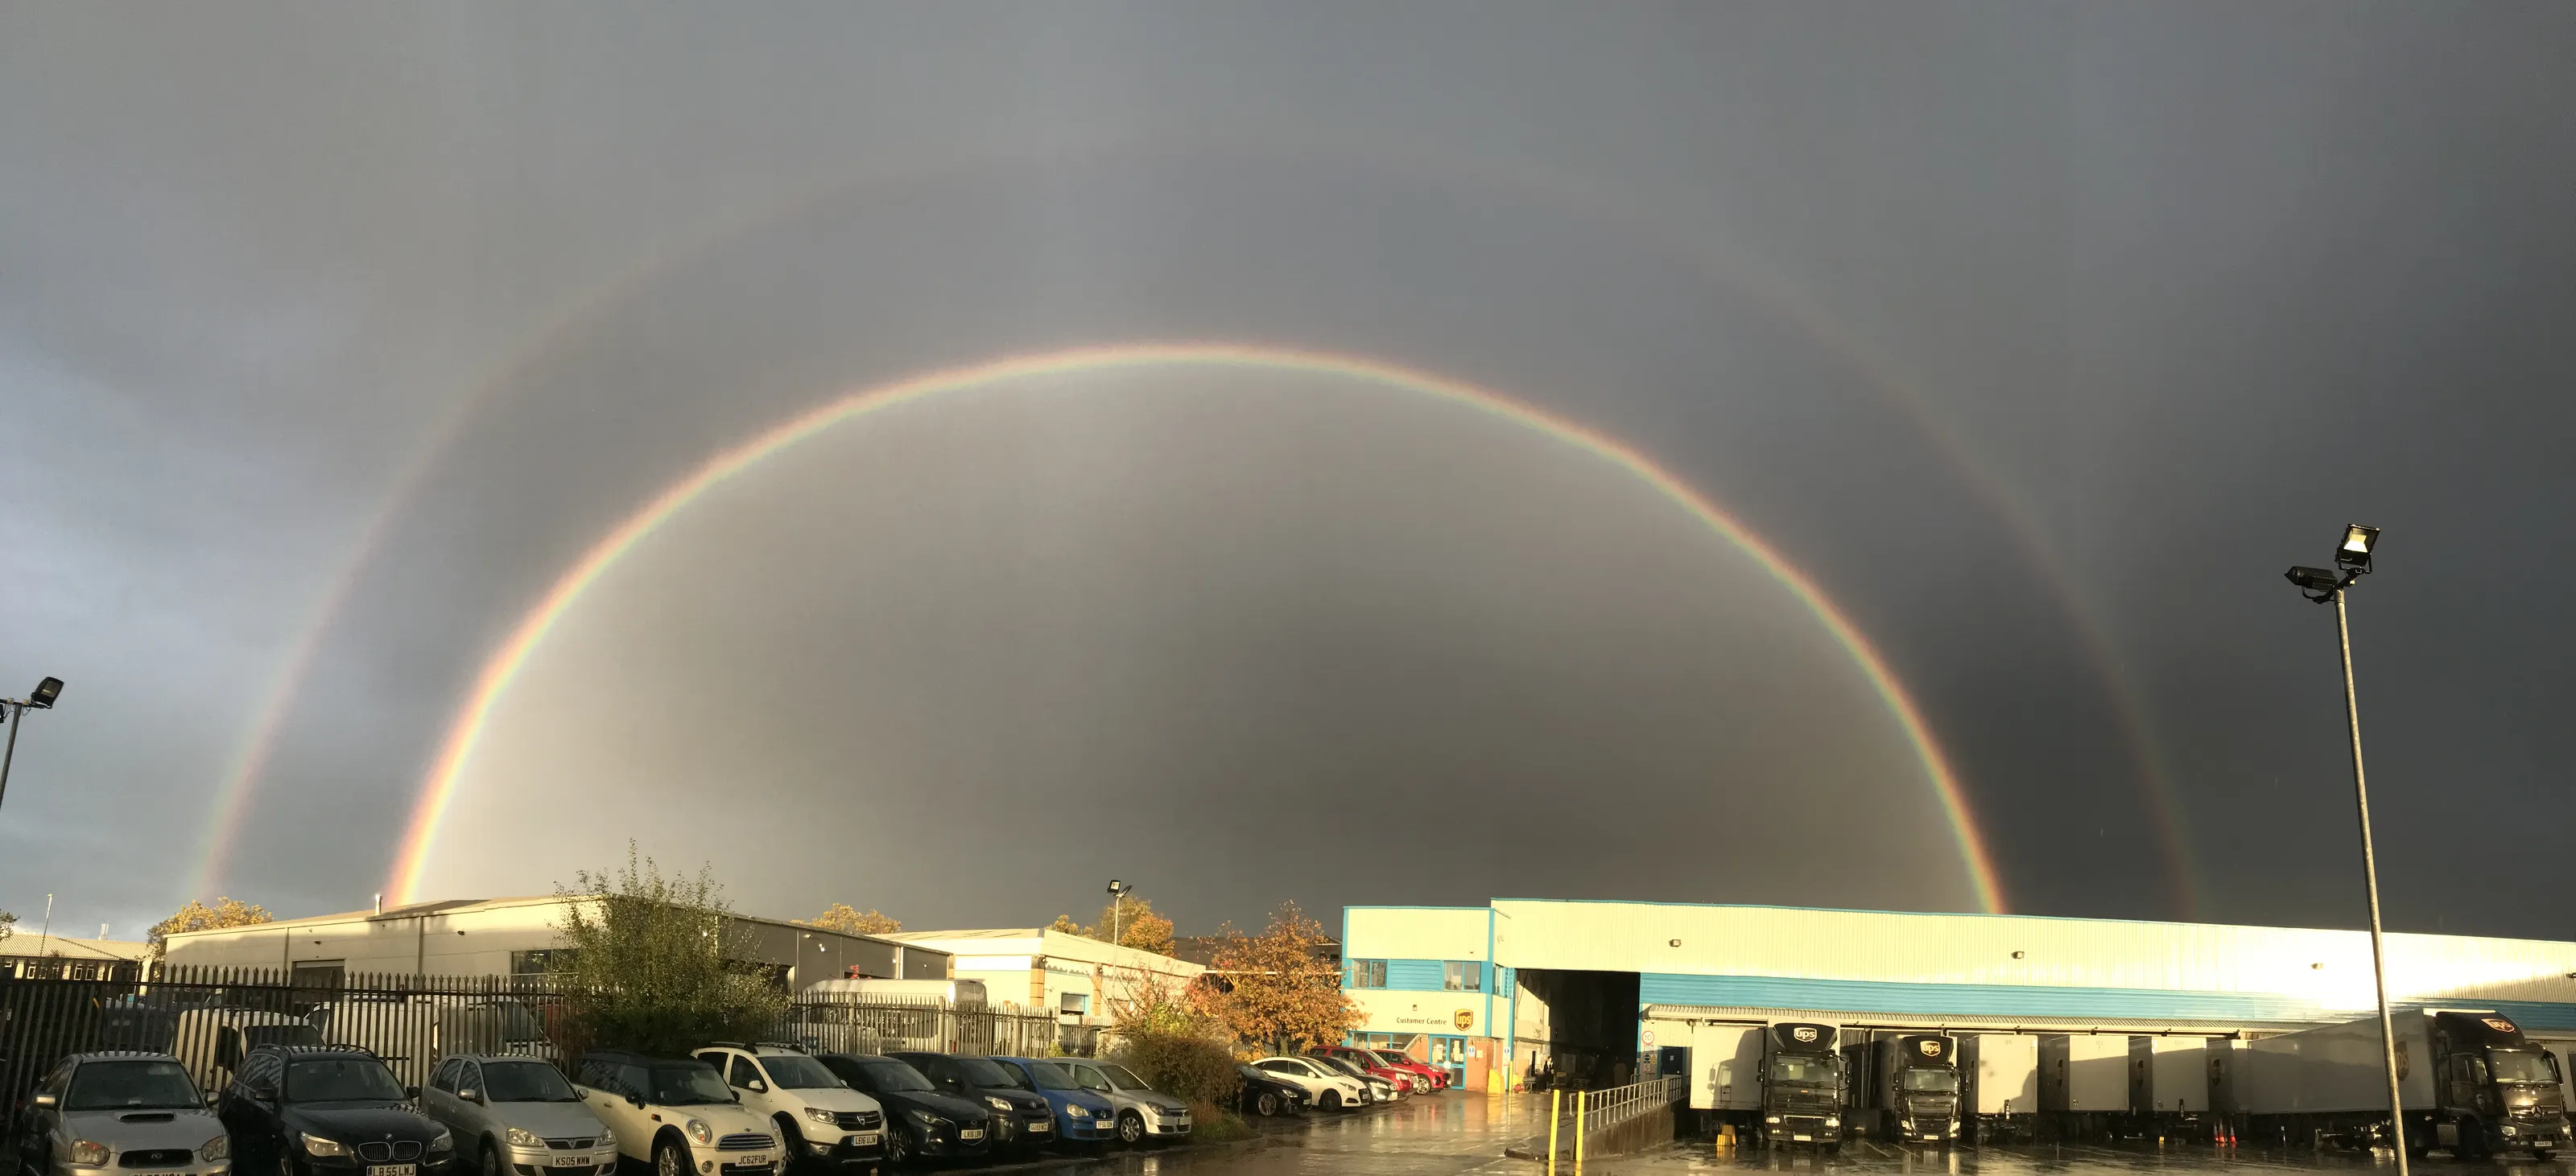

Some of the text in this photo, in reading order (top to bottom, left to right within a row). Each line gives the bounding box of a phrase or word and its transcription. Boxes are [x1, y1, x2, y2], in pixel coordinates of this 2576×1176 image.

[1396, 1017, 1447, 1025] Customer Centre
[1457, 1015, 1472, 1028] ups
[1795, 1030, 1815, 1040] ups
[1922, 1044, 1939, 1054] ups
[555, 1156, 576, 1166] KS05
[738, 1154, 767, 1165] JC62FUR
